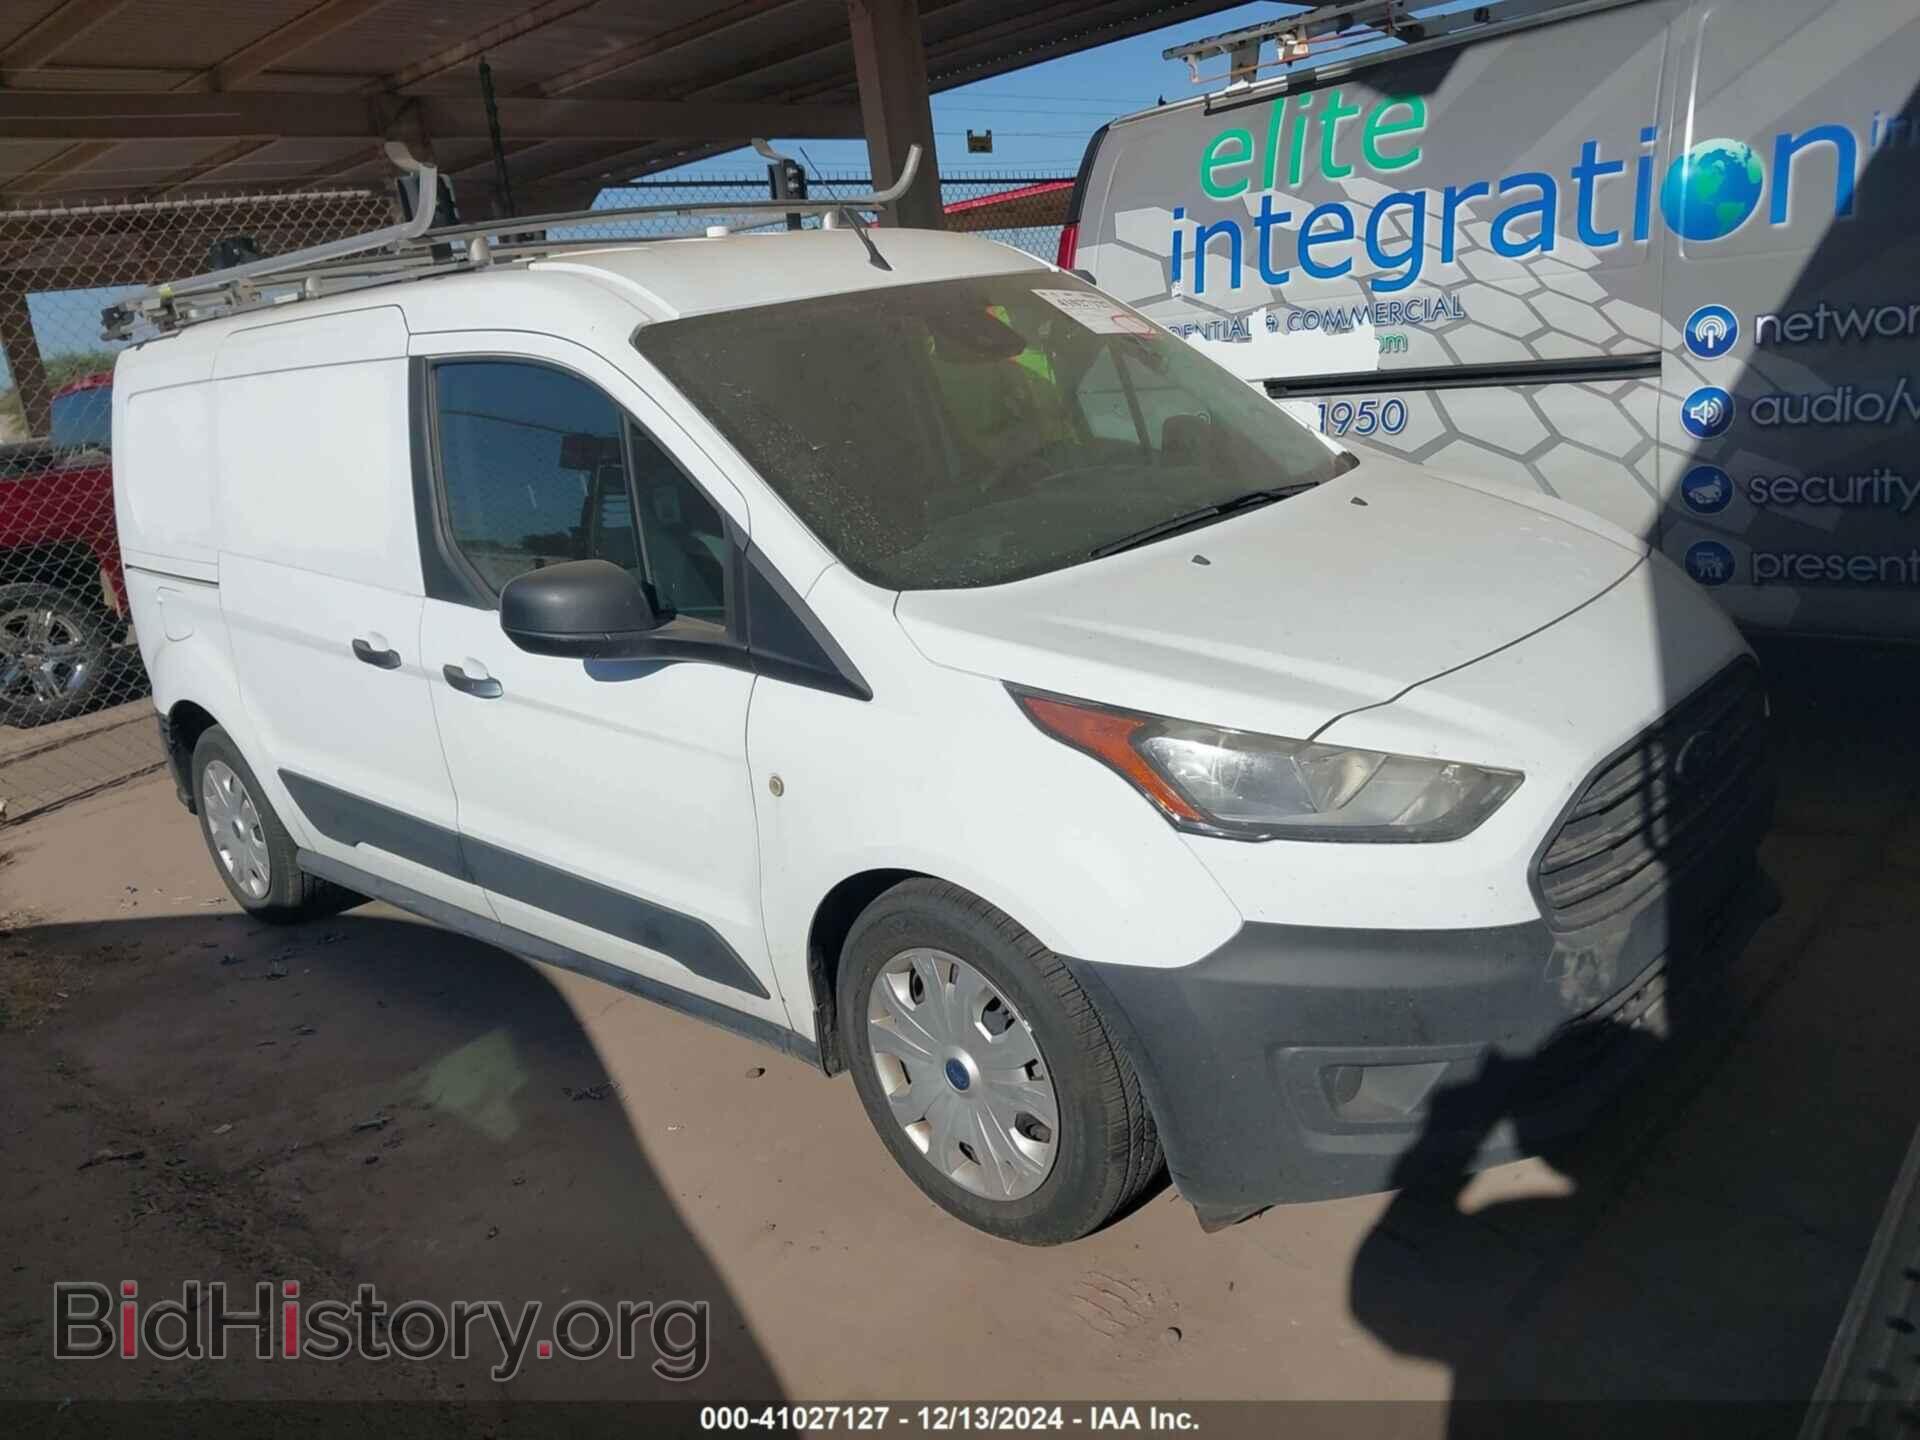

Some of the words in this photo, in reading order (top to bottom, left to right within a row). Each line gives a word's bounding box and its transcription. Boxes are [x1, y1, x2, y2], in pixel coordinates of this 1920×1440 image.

[1201, 89, 1426, 199] elite
[1286, 295, 1464, 332] COMMERCIAL
[1317, 398, 1408, 437] 1950
[1750, 467, 1920, 513] security
